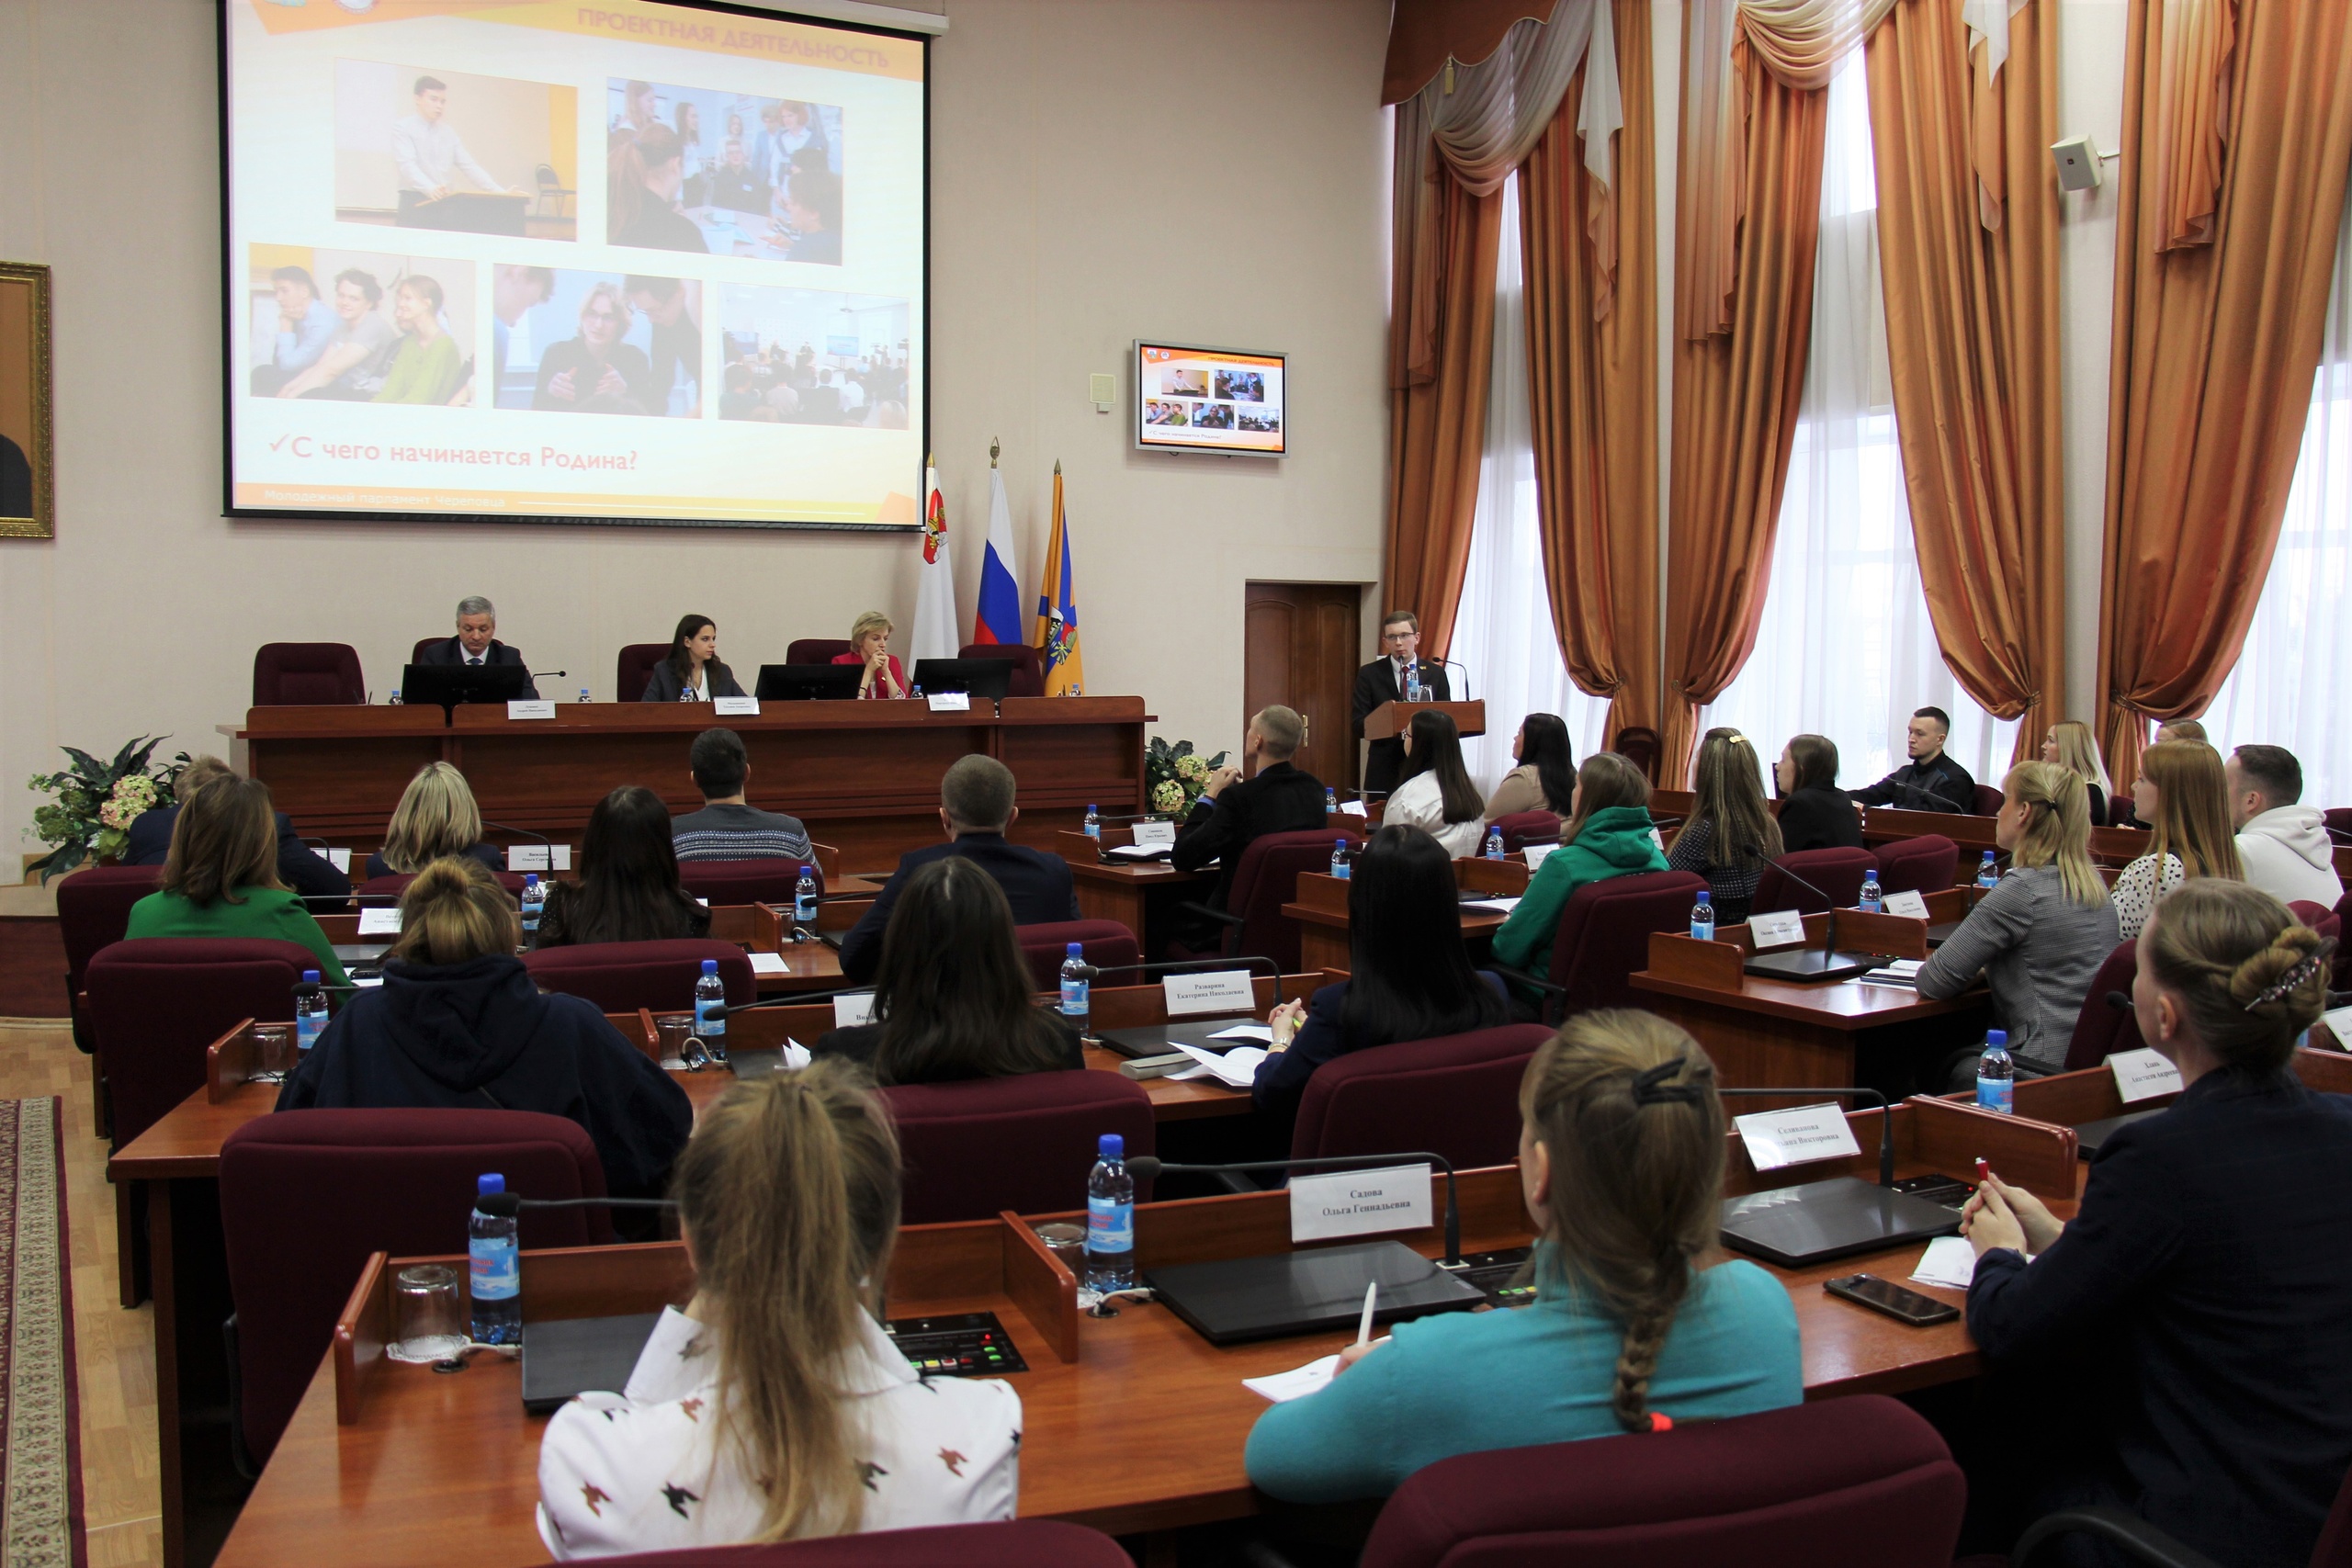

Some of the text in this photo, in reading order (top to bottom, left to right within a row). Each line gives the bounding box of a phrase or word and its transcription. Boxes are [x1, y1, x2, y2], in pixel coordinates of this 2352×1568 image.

[578, 8, 889, 68] ПРОЕКТНАЯ ДЕЯТЕЛЬНОСТЬ
[291, 435, 638, 471] С чего начинается Родина?
[359, 493, 431, 508] парламент
[435, 496, 505, 509] Череповца
[2132, 1074, 2156, 1083] Анастасия
[1777, 1123, 1820, 1135] Селиванова
[1798, 1134, 1839, 1145] Викторовна
[1350, 1189, 1383, 1200] Садова
[1322, 1200, 1411, 1217] Ольга Геннадьевна
